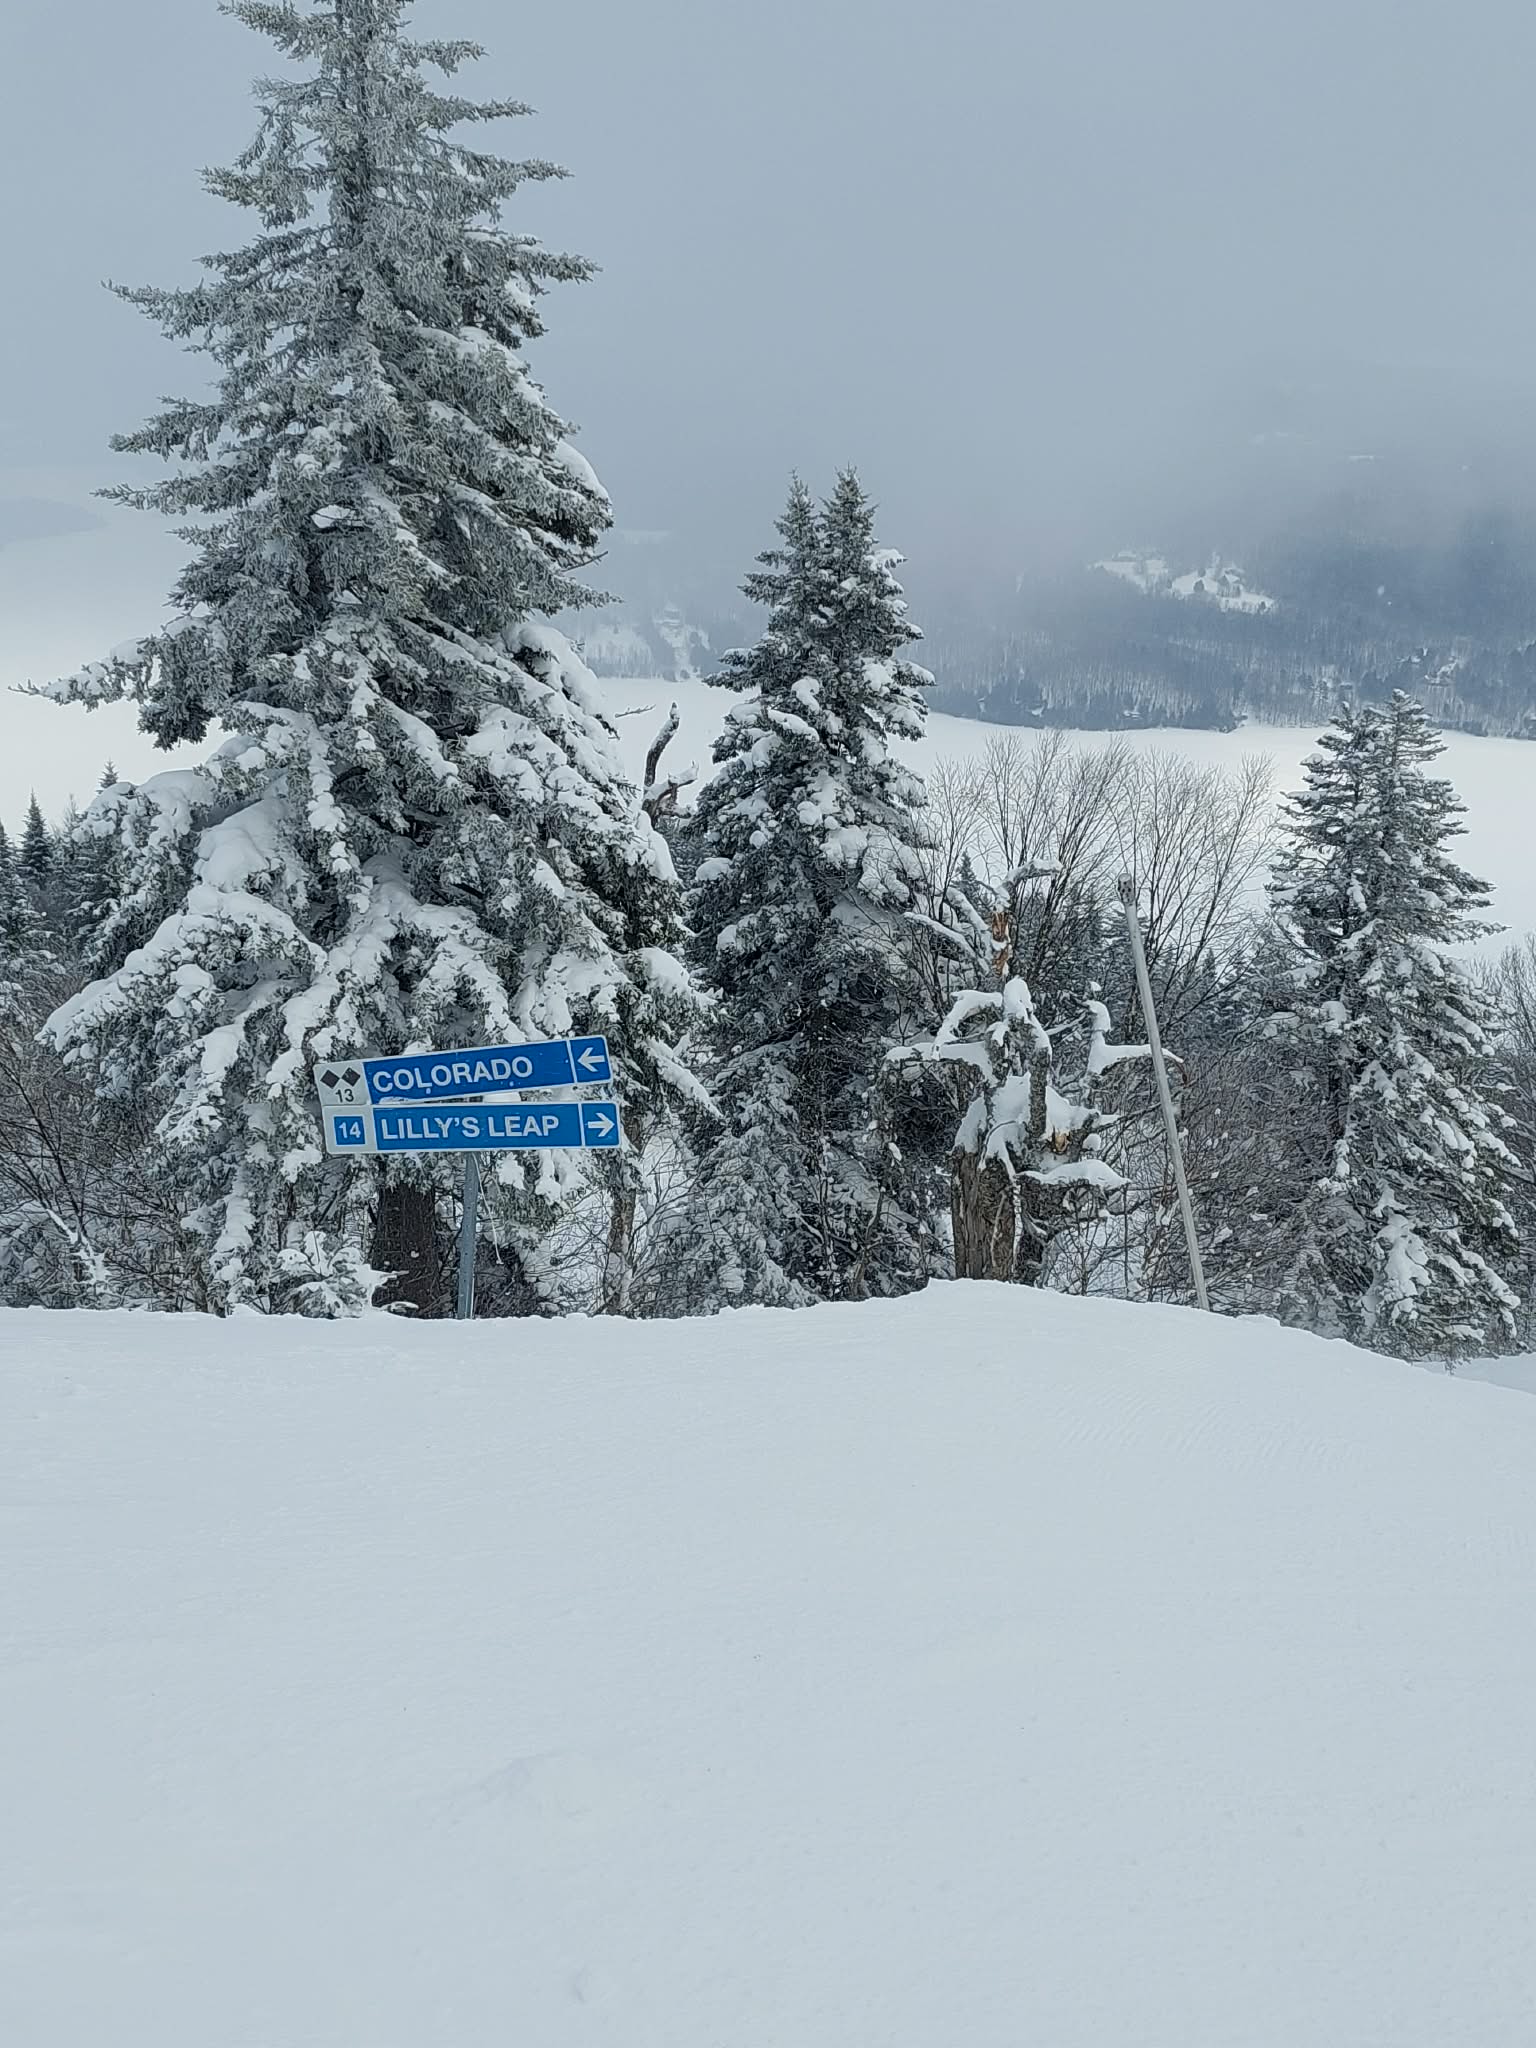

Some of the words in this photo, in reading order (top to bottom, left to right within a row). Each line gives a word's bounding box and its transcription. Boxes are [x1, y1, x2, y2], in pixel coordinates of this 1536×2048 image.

[372, 1056, 533, 1093] COLORADO
[335, 1088, 355, 1103] 13
[338, 1121, 362, 1139] 14
[381, 1116, 480, 1140] LILLY'S
[487, 1115, 559, 1137] LEAP
